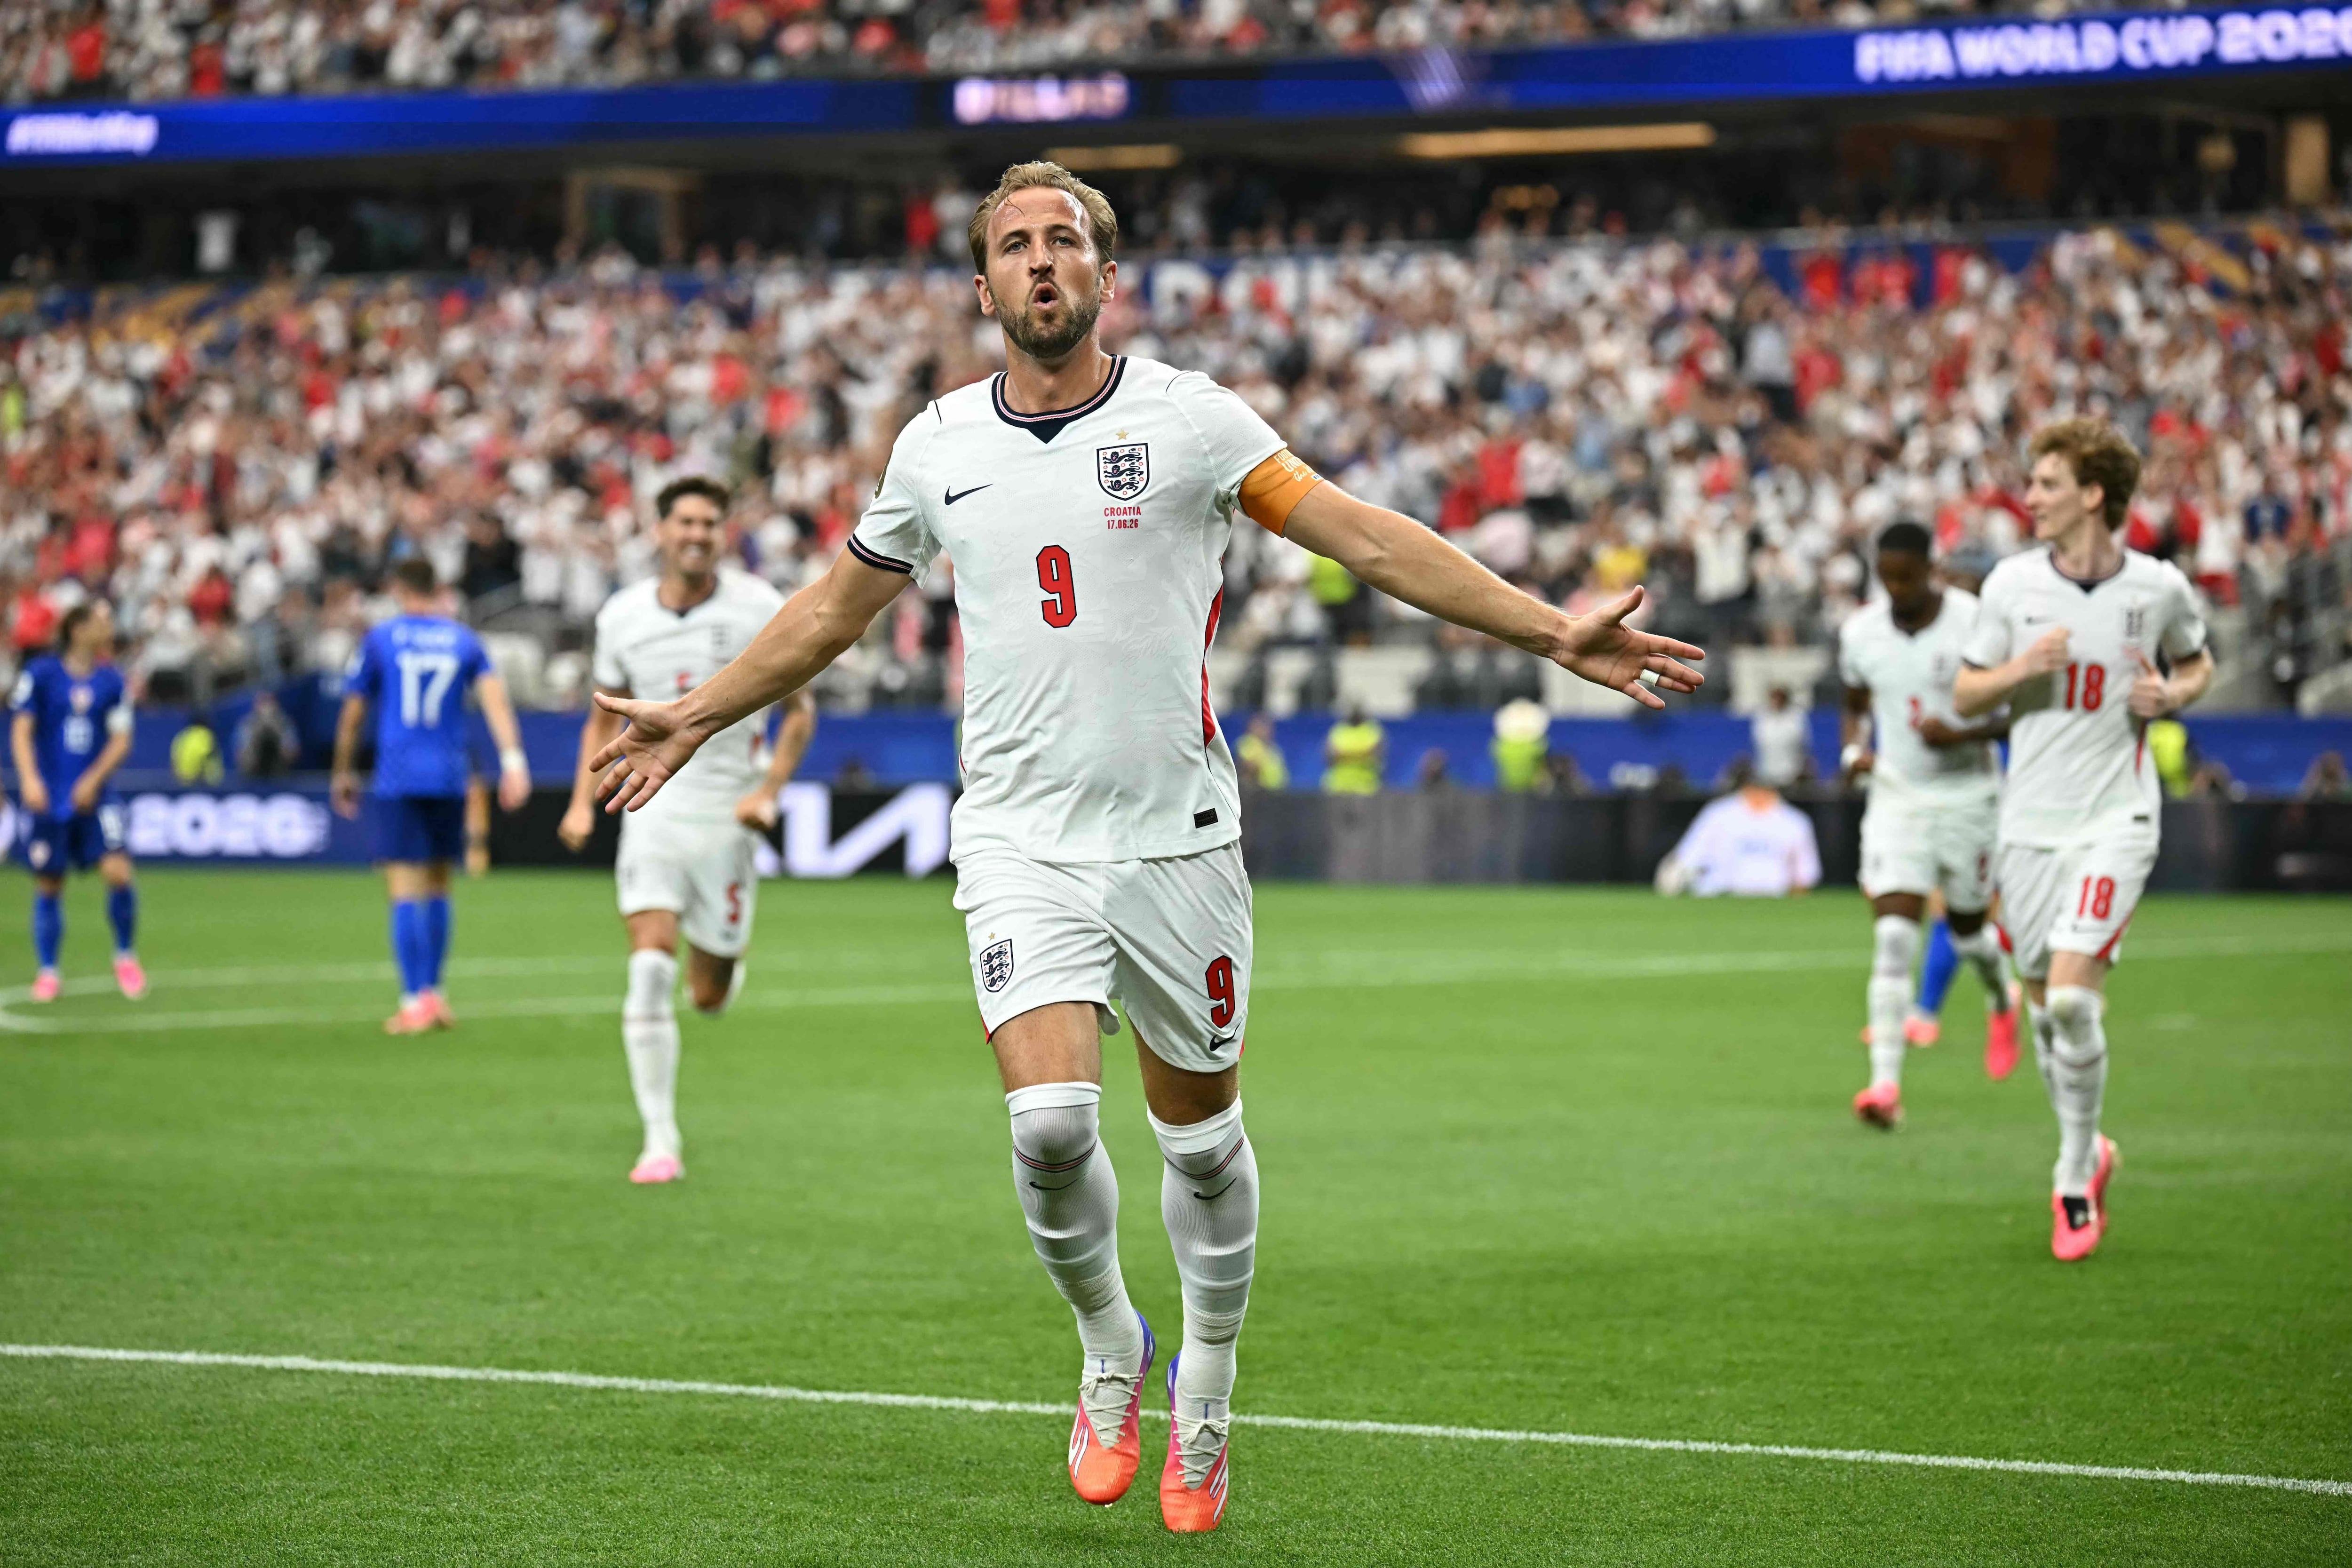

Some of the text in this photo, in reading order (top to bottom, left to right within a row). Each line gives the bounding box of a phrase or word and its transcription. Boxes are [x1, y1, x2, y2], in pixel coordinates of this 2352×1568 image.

[1854, 29, 1955, 83] FIFA
[1953, 20, 2118, 78] WORLD
[2120, 15, 2213, 69] CUP
[1104, 506, 1142, 517] CROATIA
[1107, 518, 1139, 530] 17.06.26
[1036, 544, 1077, 629] 9
[396, 651, 461, 730] 17
[2065, 661, 2106, 713] 18
[127, 792, 313, 858] 2026
[726, 881, 742, 925] 5
[2077, 875, 2116, 921] 18
[1205, 955, 1235, 1029] 9
